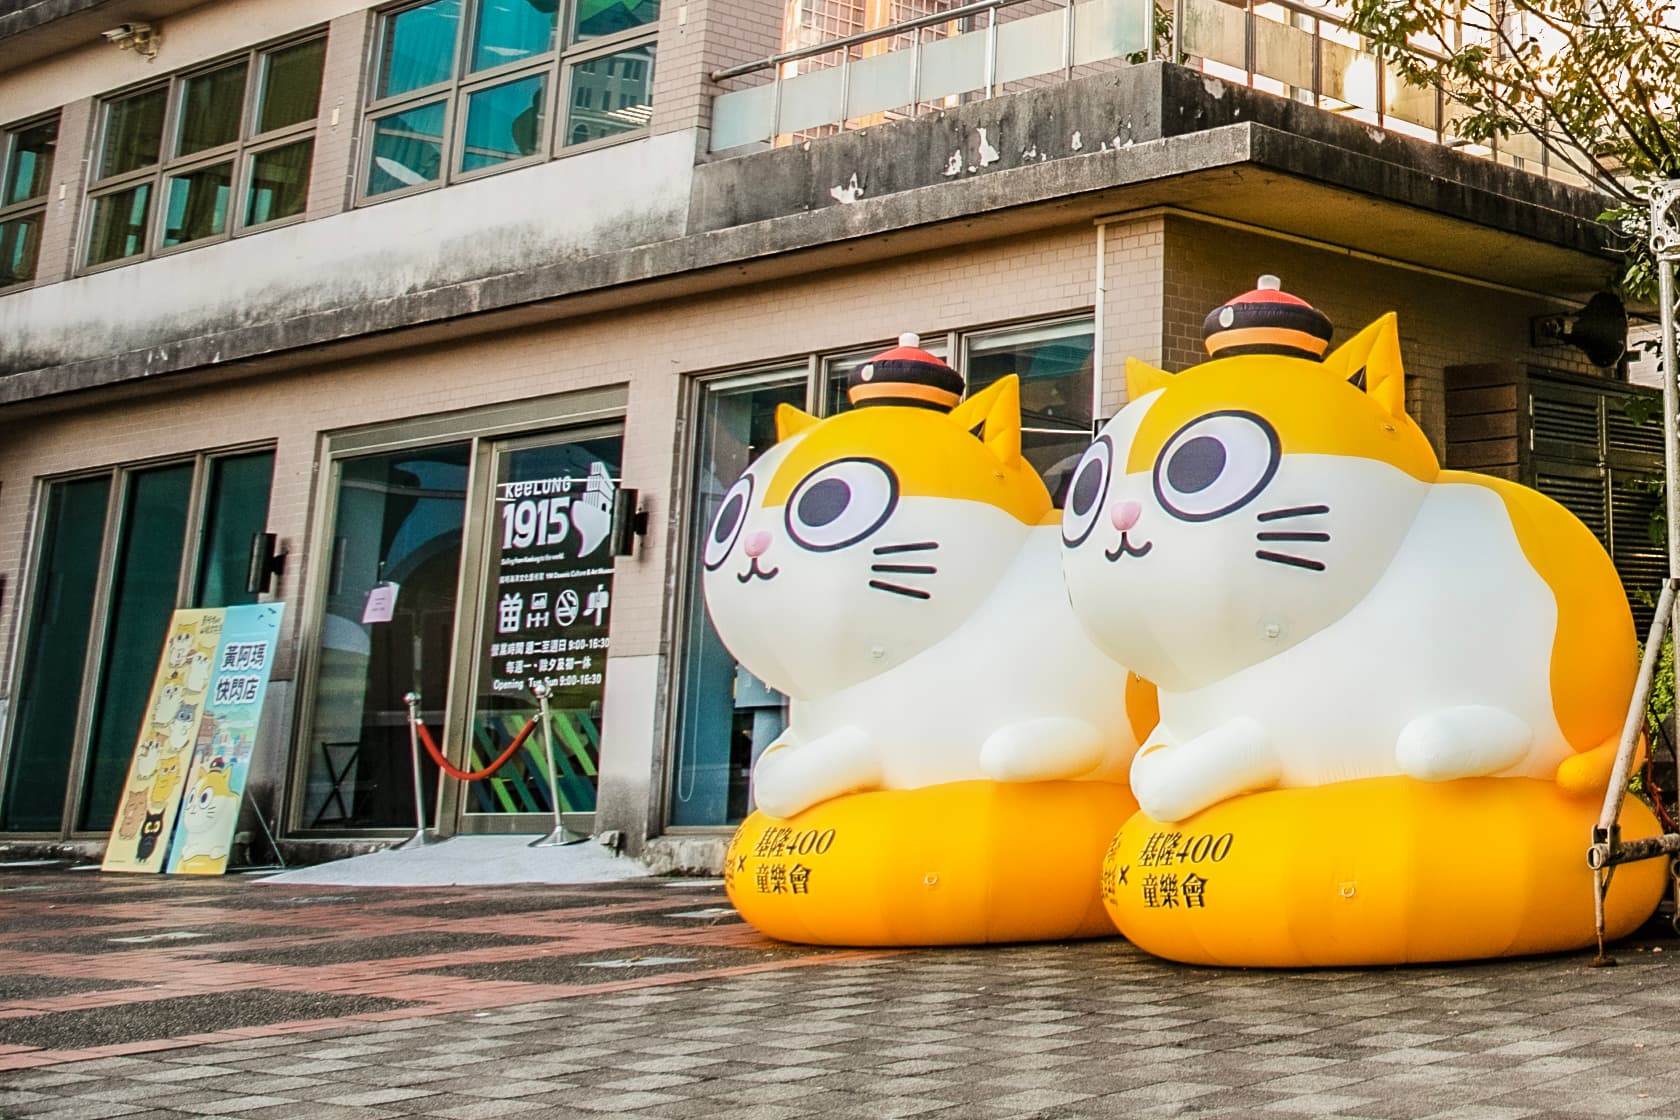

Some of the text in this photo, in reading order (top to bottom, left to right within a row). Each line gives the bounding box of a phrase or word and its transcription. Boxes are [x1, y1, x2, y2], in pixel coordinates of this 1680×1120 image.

[502, 496, 570, 550] 1915
[222, 643, 267, 669] 黃阿瑪
[215, 677, 259, 701] 快閃店
[493, 679, 524, 692] Opening
[753, 826, 836, 858] 基隆400
[1138, 832, 1234, 867] 基隆400
[755, 863, 813, 895] 童樂會
[1142, 873, 1209, 909] 童樂會
